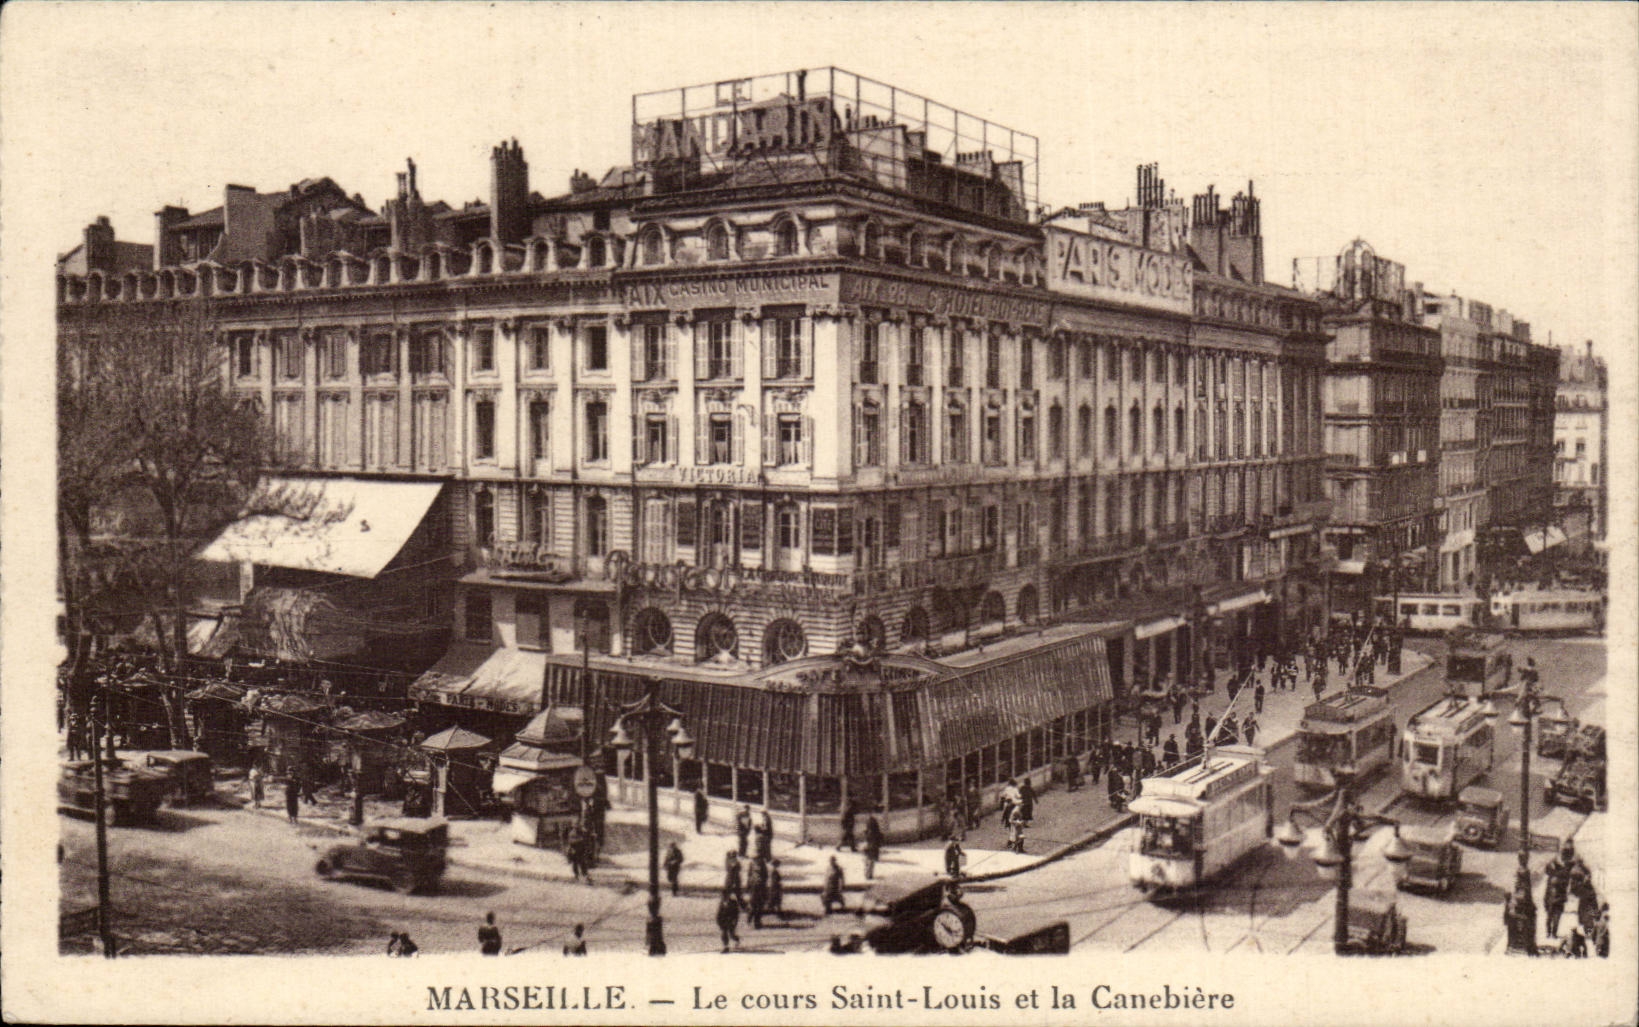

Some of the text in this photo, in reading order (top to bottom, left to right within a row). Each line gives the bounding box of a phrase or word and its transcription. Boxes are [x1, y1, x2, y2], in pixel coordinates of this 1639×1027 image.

[668, 278, 729, 298] CASINO
[735, 273, 830, 294] MUNICIPAL
[678, 466, 764, 486] VICTORIA
